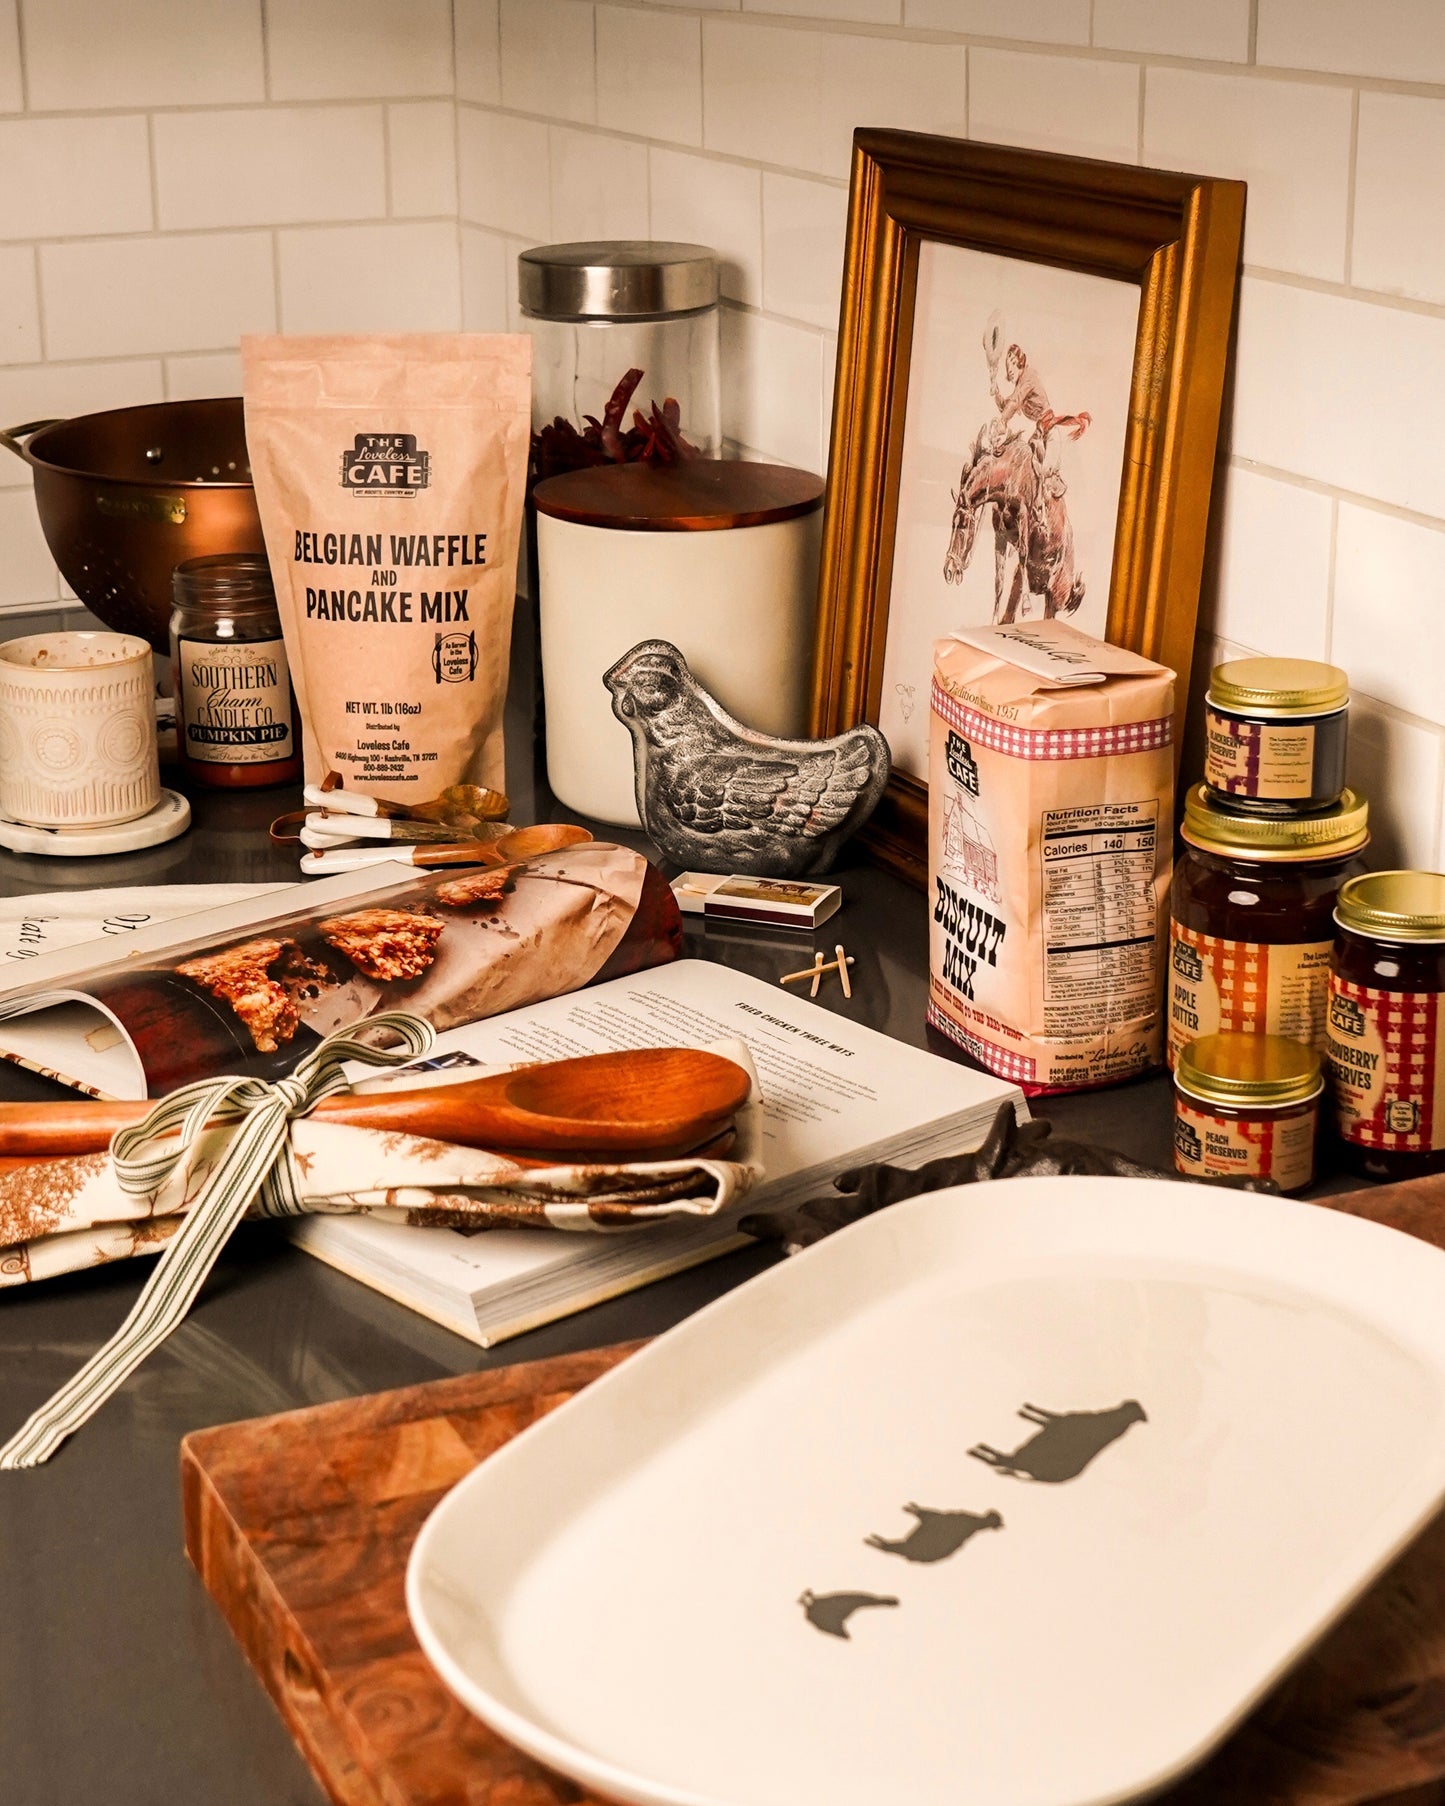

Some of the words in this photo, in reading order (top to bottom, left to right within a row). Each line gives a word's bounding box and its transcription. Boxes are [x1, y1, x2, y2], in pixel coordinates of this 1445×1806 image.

[366, 438, 403, 448] THE
[357, 446, 413, 461] Loveless
[348, 465, 422, 485] CAFE
[294, 530, 382, 566] BELGIAN
[389, 533, 487, 567] WAFFLE
[371, 570, 397, 587] AND
[306, 588, 412, 622] PANCAKE
[420, 589, 469, 623] MIX
[443, 657, 469, 666] Loveless
[449, 666, 463, 675] Cafe
[191, 663, 277, 690] SOUTHERN
[207, 688, 263, 709] Charm
[346, 701, 361, 714] NET
[363, 702, 379, 715] WT.
[381, 702, 393, 715] 1lb
[394, 702, 422, 715] (16oz)
[197, 706, 250, 729] CANDLE
[255, 706, 276, 727] CO.
[996, 704, 1020, 721] 1951
[191, 727, 256, 743] PUMPKIN
[261, 726, 284, 741] PIE
[357, 739, 391, 751] Loveless
[392, 739, 410, 751] Cafe
[952, 736, 967, 754] THE
[370, 754, 380, 762] 100
[948, 757, 978, 792] CAFE
[1046, 808, 1100, 821] Nutrition
[1104, 805, 1139, 815] Facts
[1044, 843, 1088, 857] Calories
[1103, 839, 1123, 850] 140
[1136, 836, 1155, 848] 150
[934, 876, 1006, 967] BISCUIT
[1314, 951, 1329, 960] Love
[942, 938, 977, 1002] MIX
[1173, 956, 1201, 981] CAFE
[1174, 983, 1197, 1010] APPLE
[1172, 1001, 1199, 1031] BUTTER
[1331, 1011, 1361, 1034] CAFE
[734, 1002, 762, 1017] FRIED
[760, 1014, 803, 1033] CHICKEN
[798, 1030, 830, 1046] THREE
[827, 1043, 856, 1057] WAYS
[1089, 1047, 1127, 1063] Loveless
[1129, 1042, 1148, 1057] Cafe
[1205, 1131, 1229, 1147] PEACH
[1205, 1143, 1248, 1160] PRESERVES
